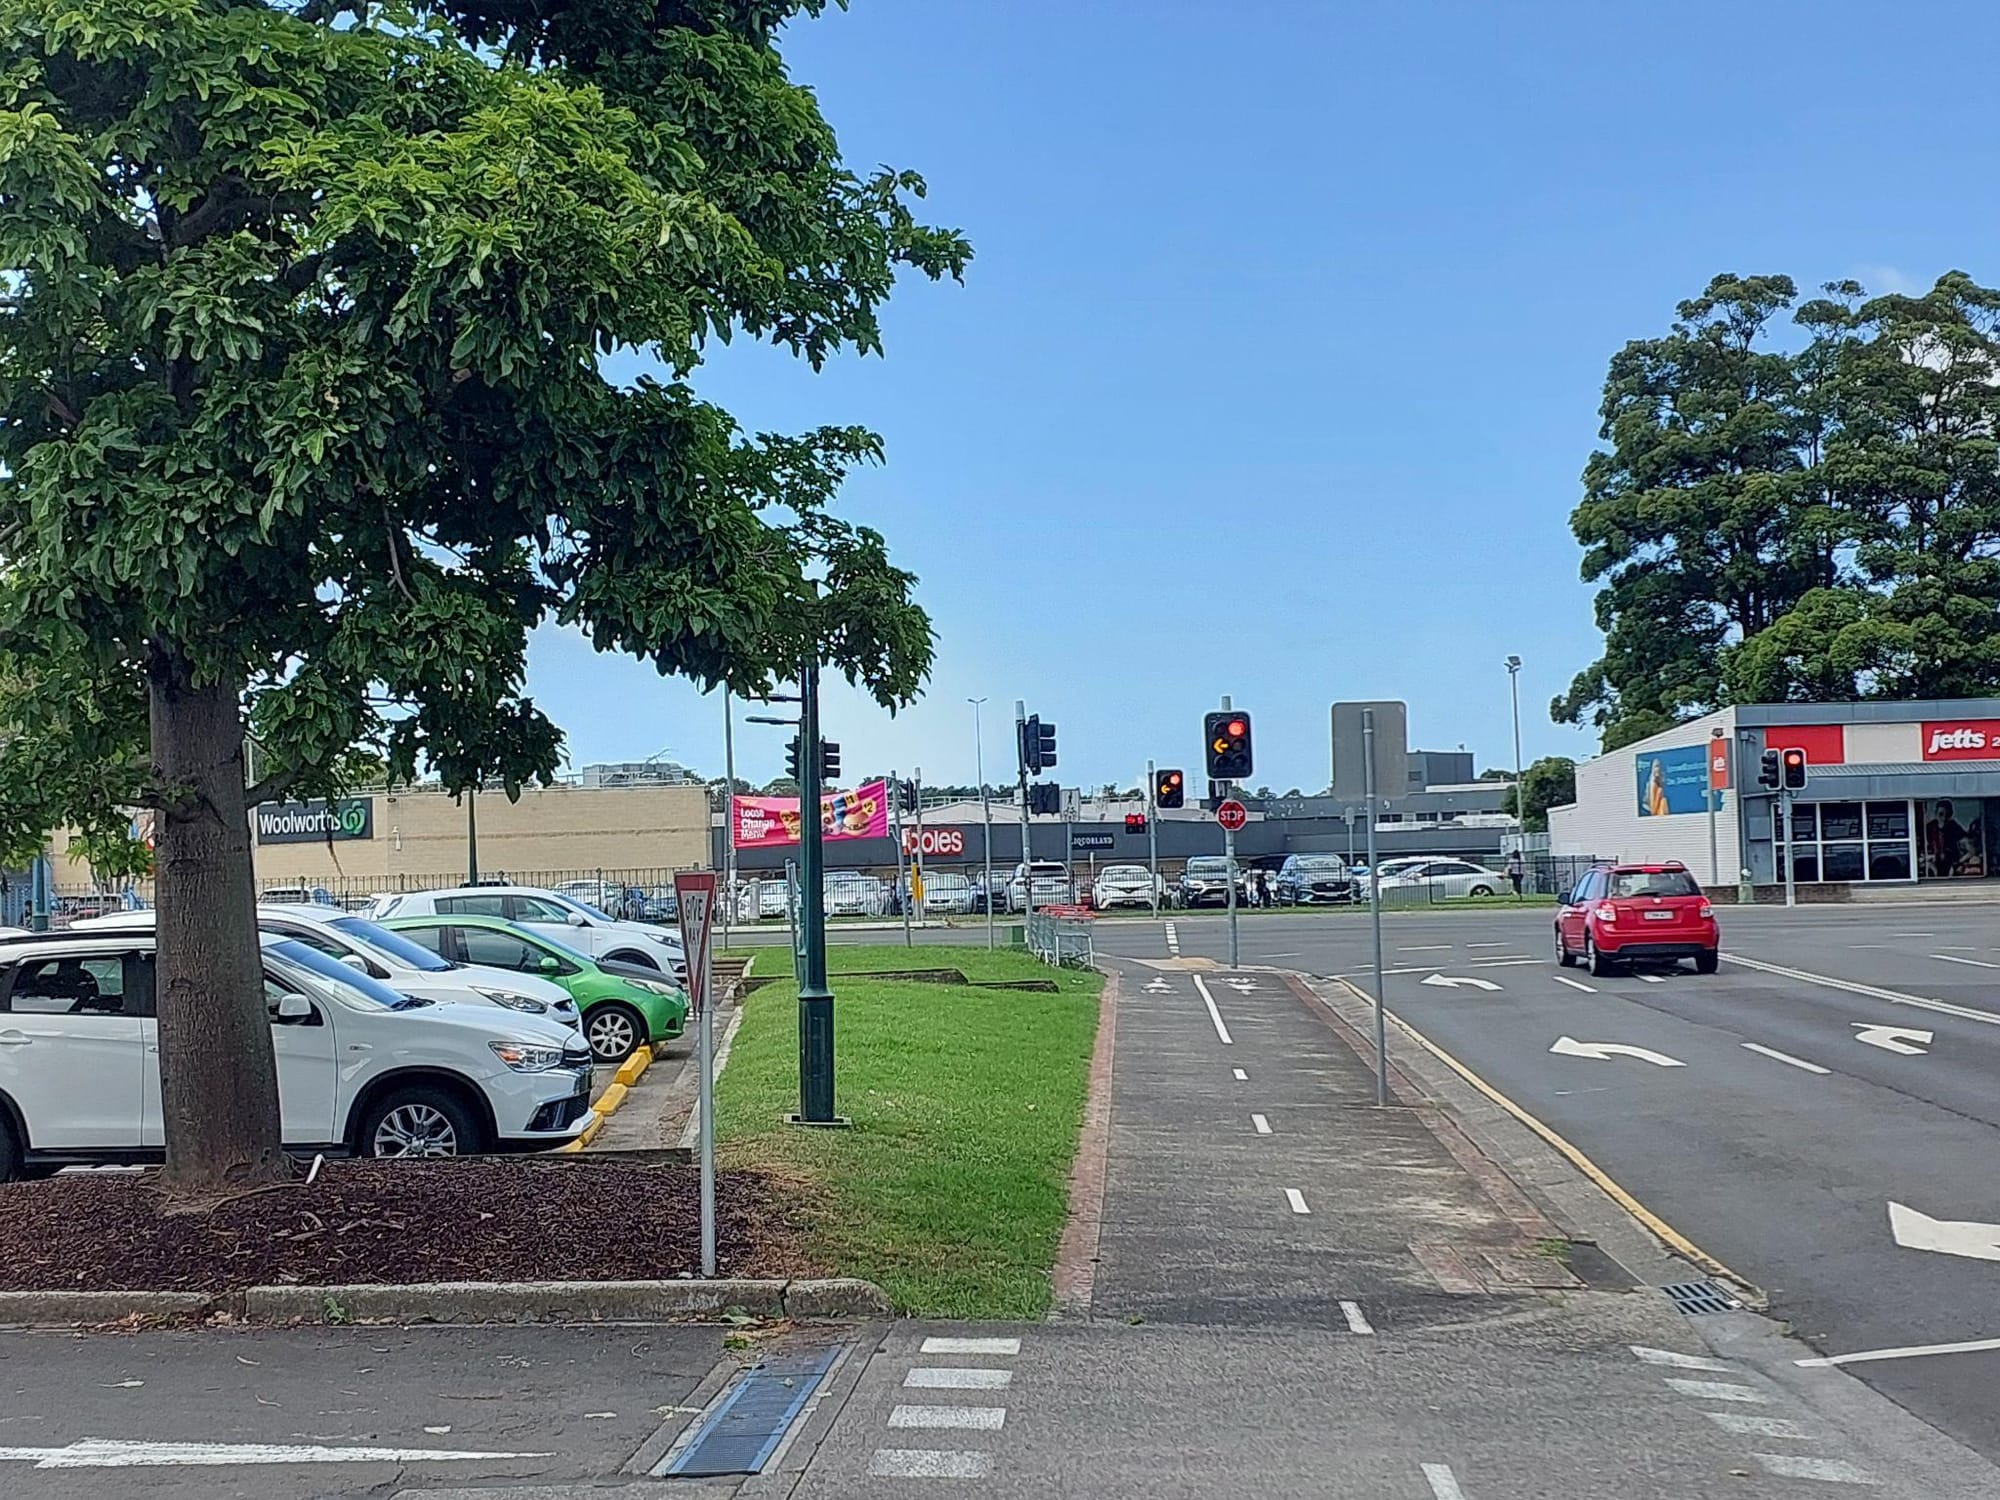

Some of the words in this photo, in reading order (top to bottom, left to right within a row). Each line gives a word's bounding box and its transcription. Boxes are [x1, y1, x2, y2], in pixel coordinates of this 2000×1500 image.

[1928, 729, 1986, 753] jetts
[1220, 810, 1244, 821] STOP
[740, 818, 776, 831] Change
[740, 829, 766, 840] Menu
[902, 830, 963, 853] oles
[1071, 836, 1113, 847] IQUORLAND
